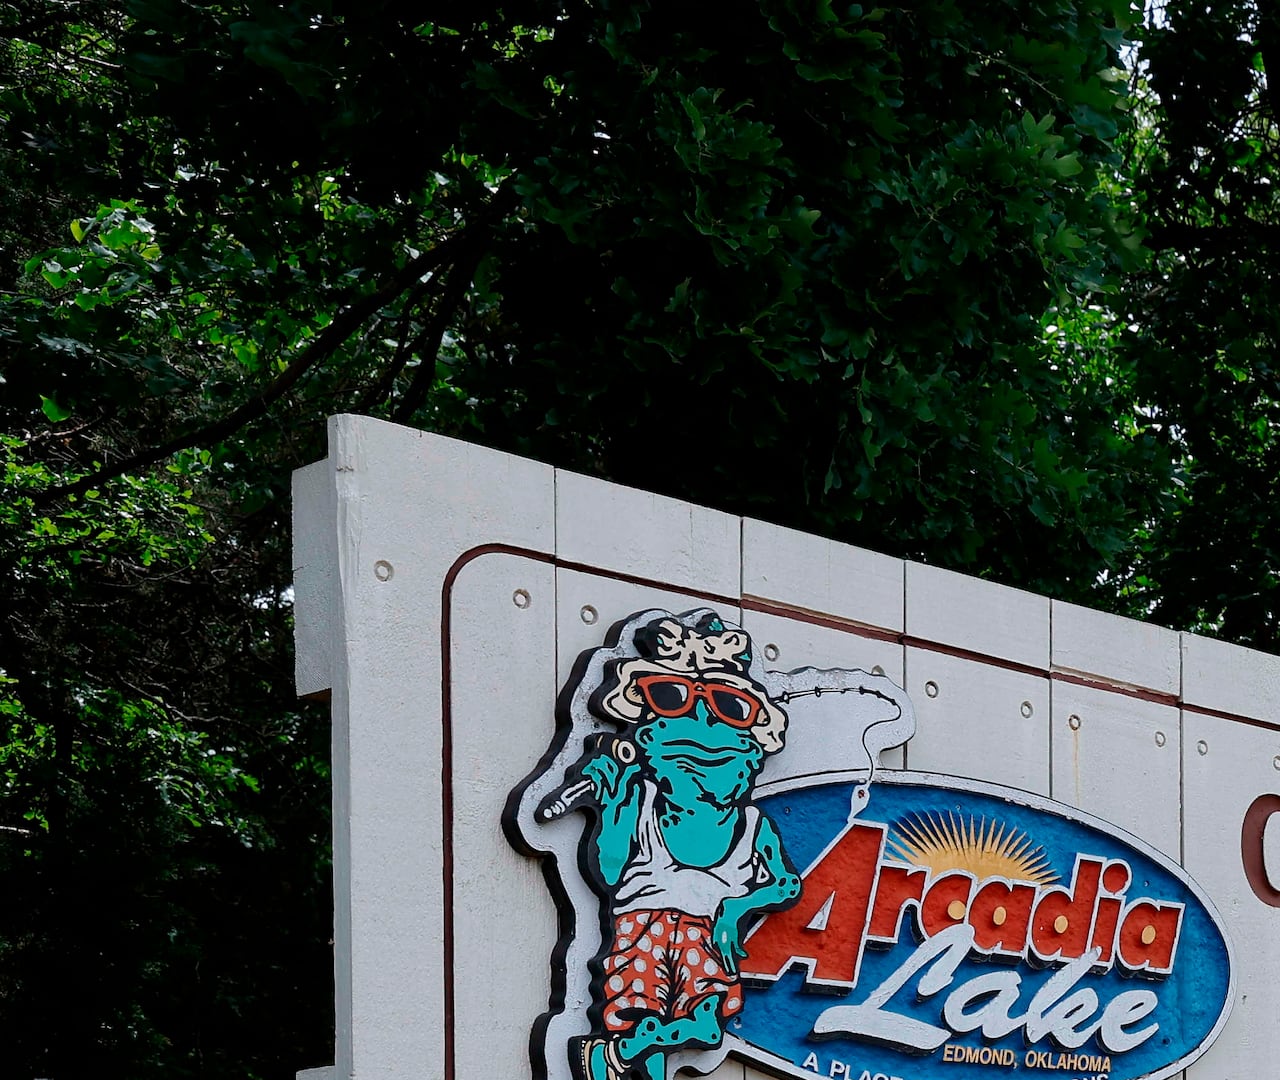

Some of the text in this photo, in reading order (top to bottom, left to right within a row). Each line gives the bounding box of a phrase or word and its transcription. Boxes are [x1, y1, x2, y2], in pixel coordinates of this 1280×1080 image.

[740, 819, 1186, 988] Arcadia
[813, 923, 1160, 1054] Lake
[802, 1051, 819, 1073] A
[942, 1044, 1111, 1073] EDMOND, OKLAHOMA
